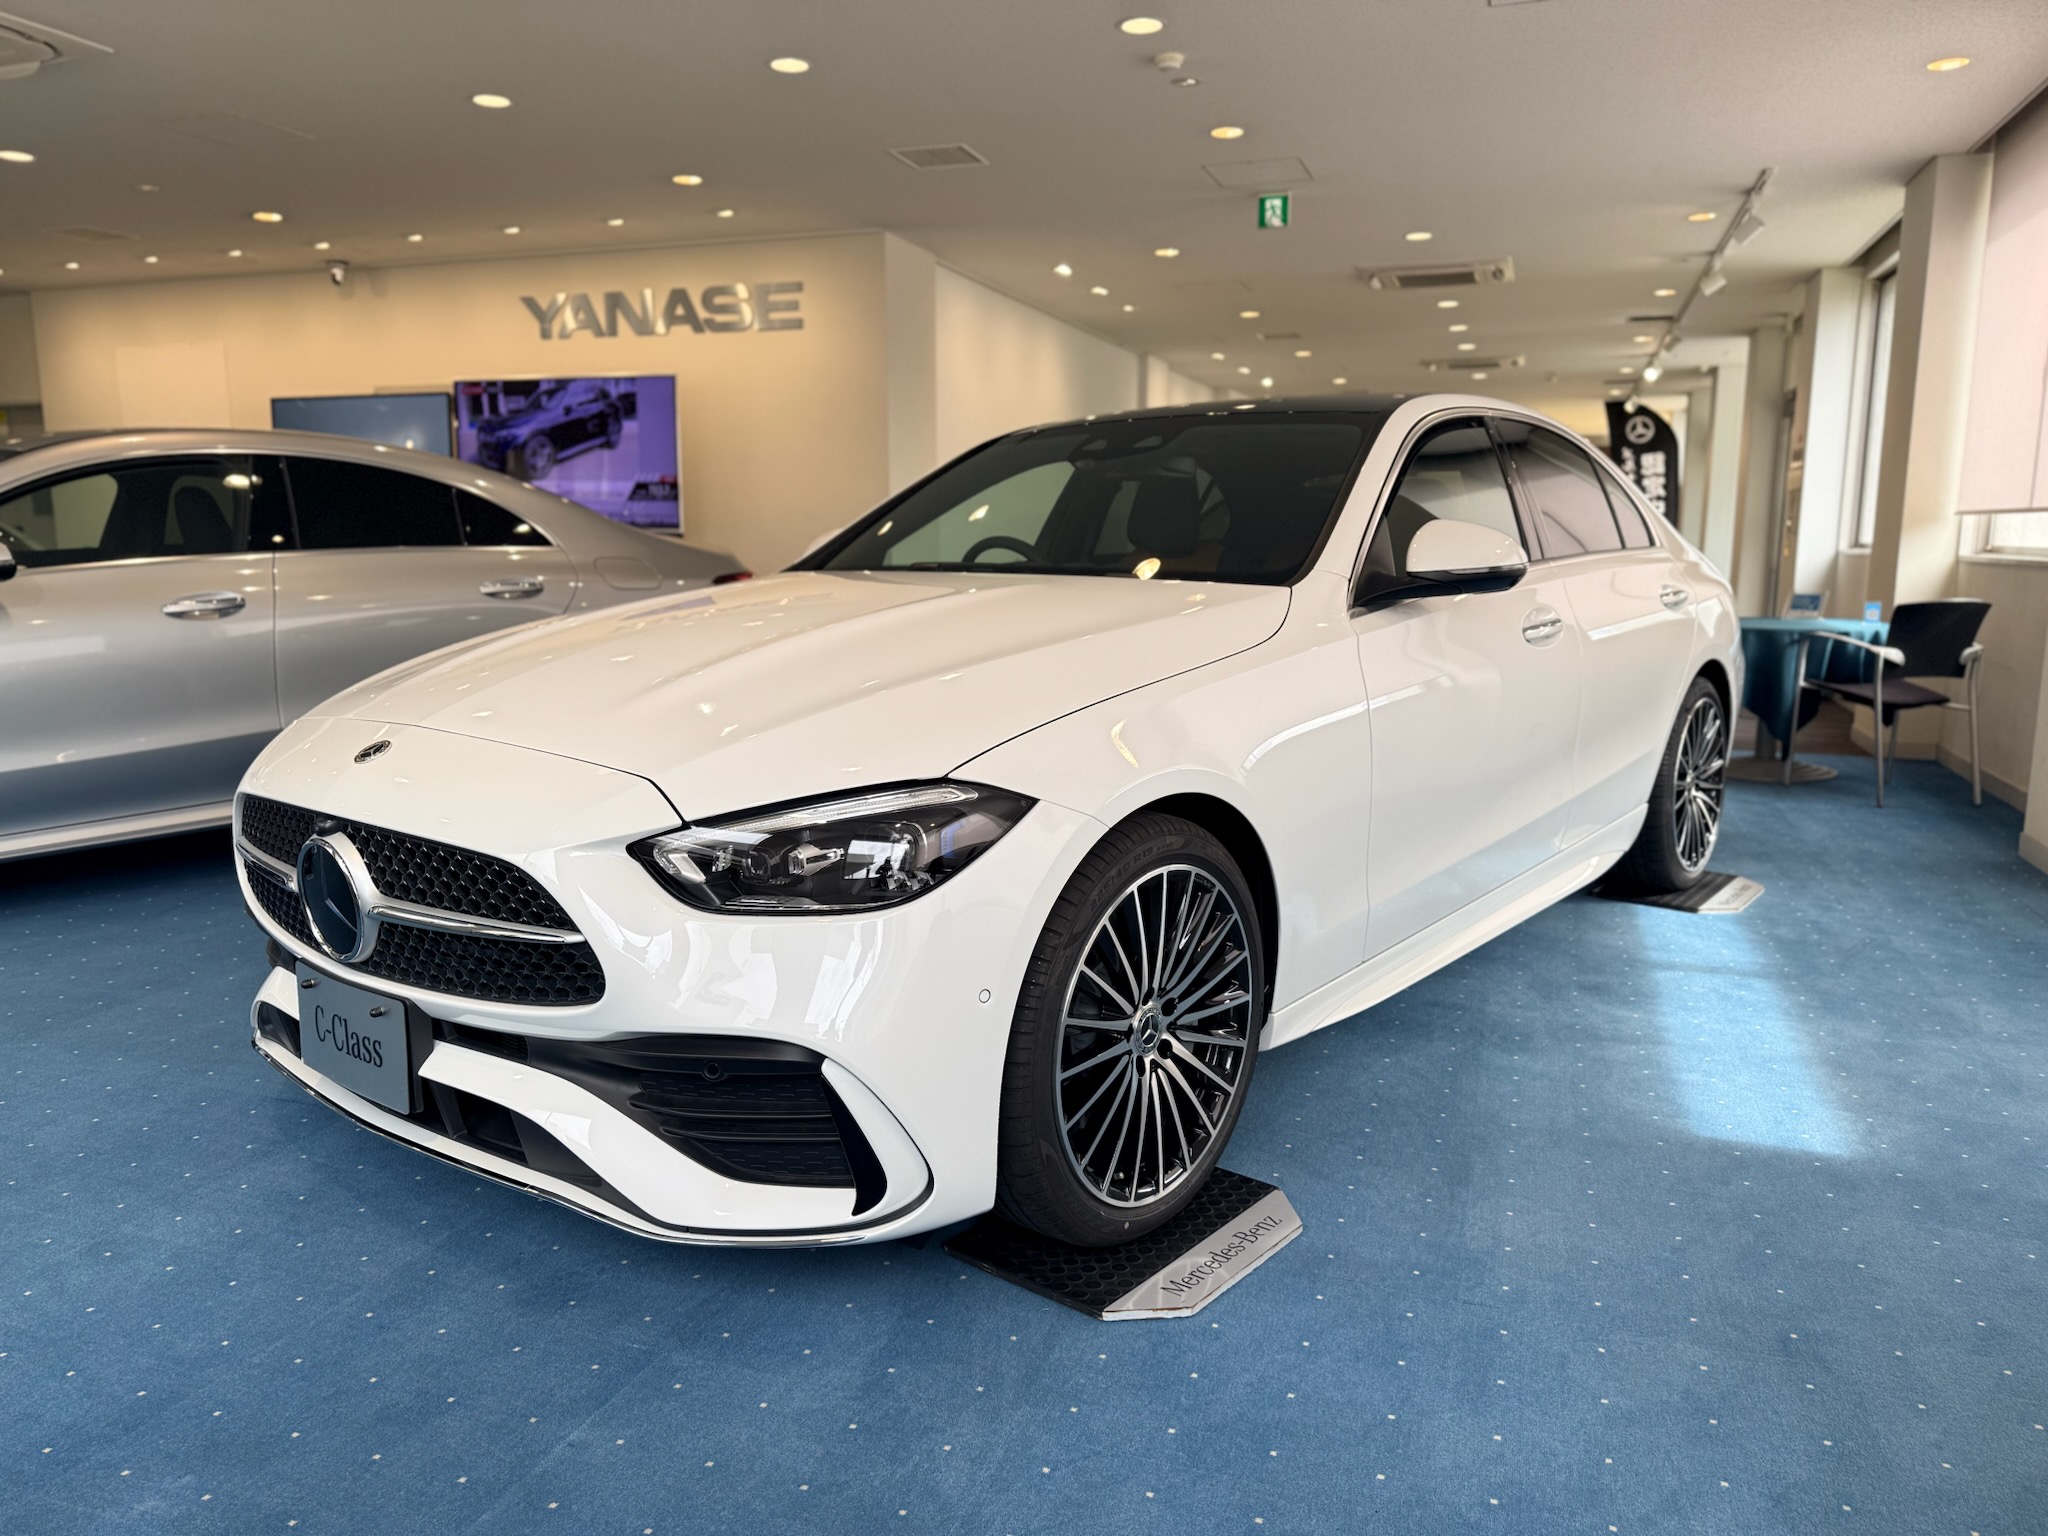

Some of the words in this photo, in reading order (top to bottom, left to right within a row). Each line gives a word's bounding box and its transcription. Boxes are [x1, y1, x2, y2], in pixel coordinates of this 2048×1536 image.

[519, 281, 804, 340] YANASE
[314, 1004, 383, 1068] C-Class
[1159, 1215, 1283, 1297] Mercedes-Benz
